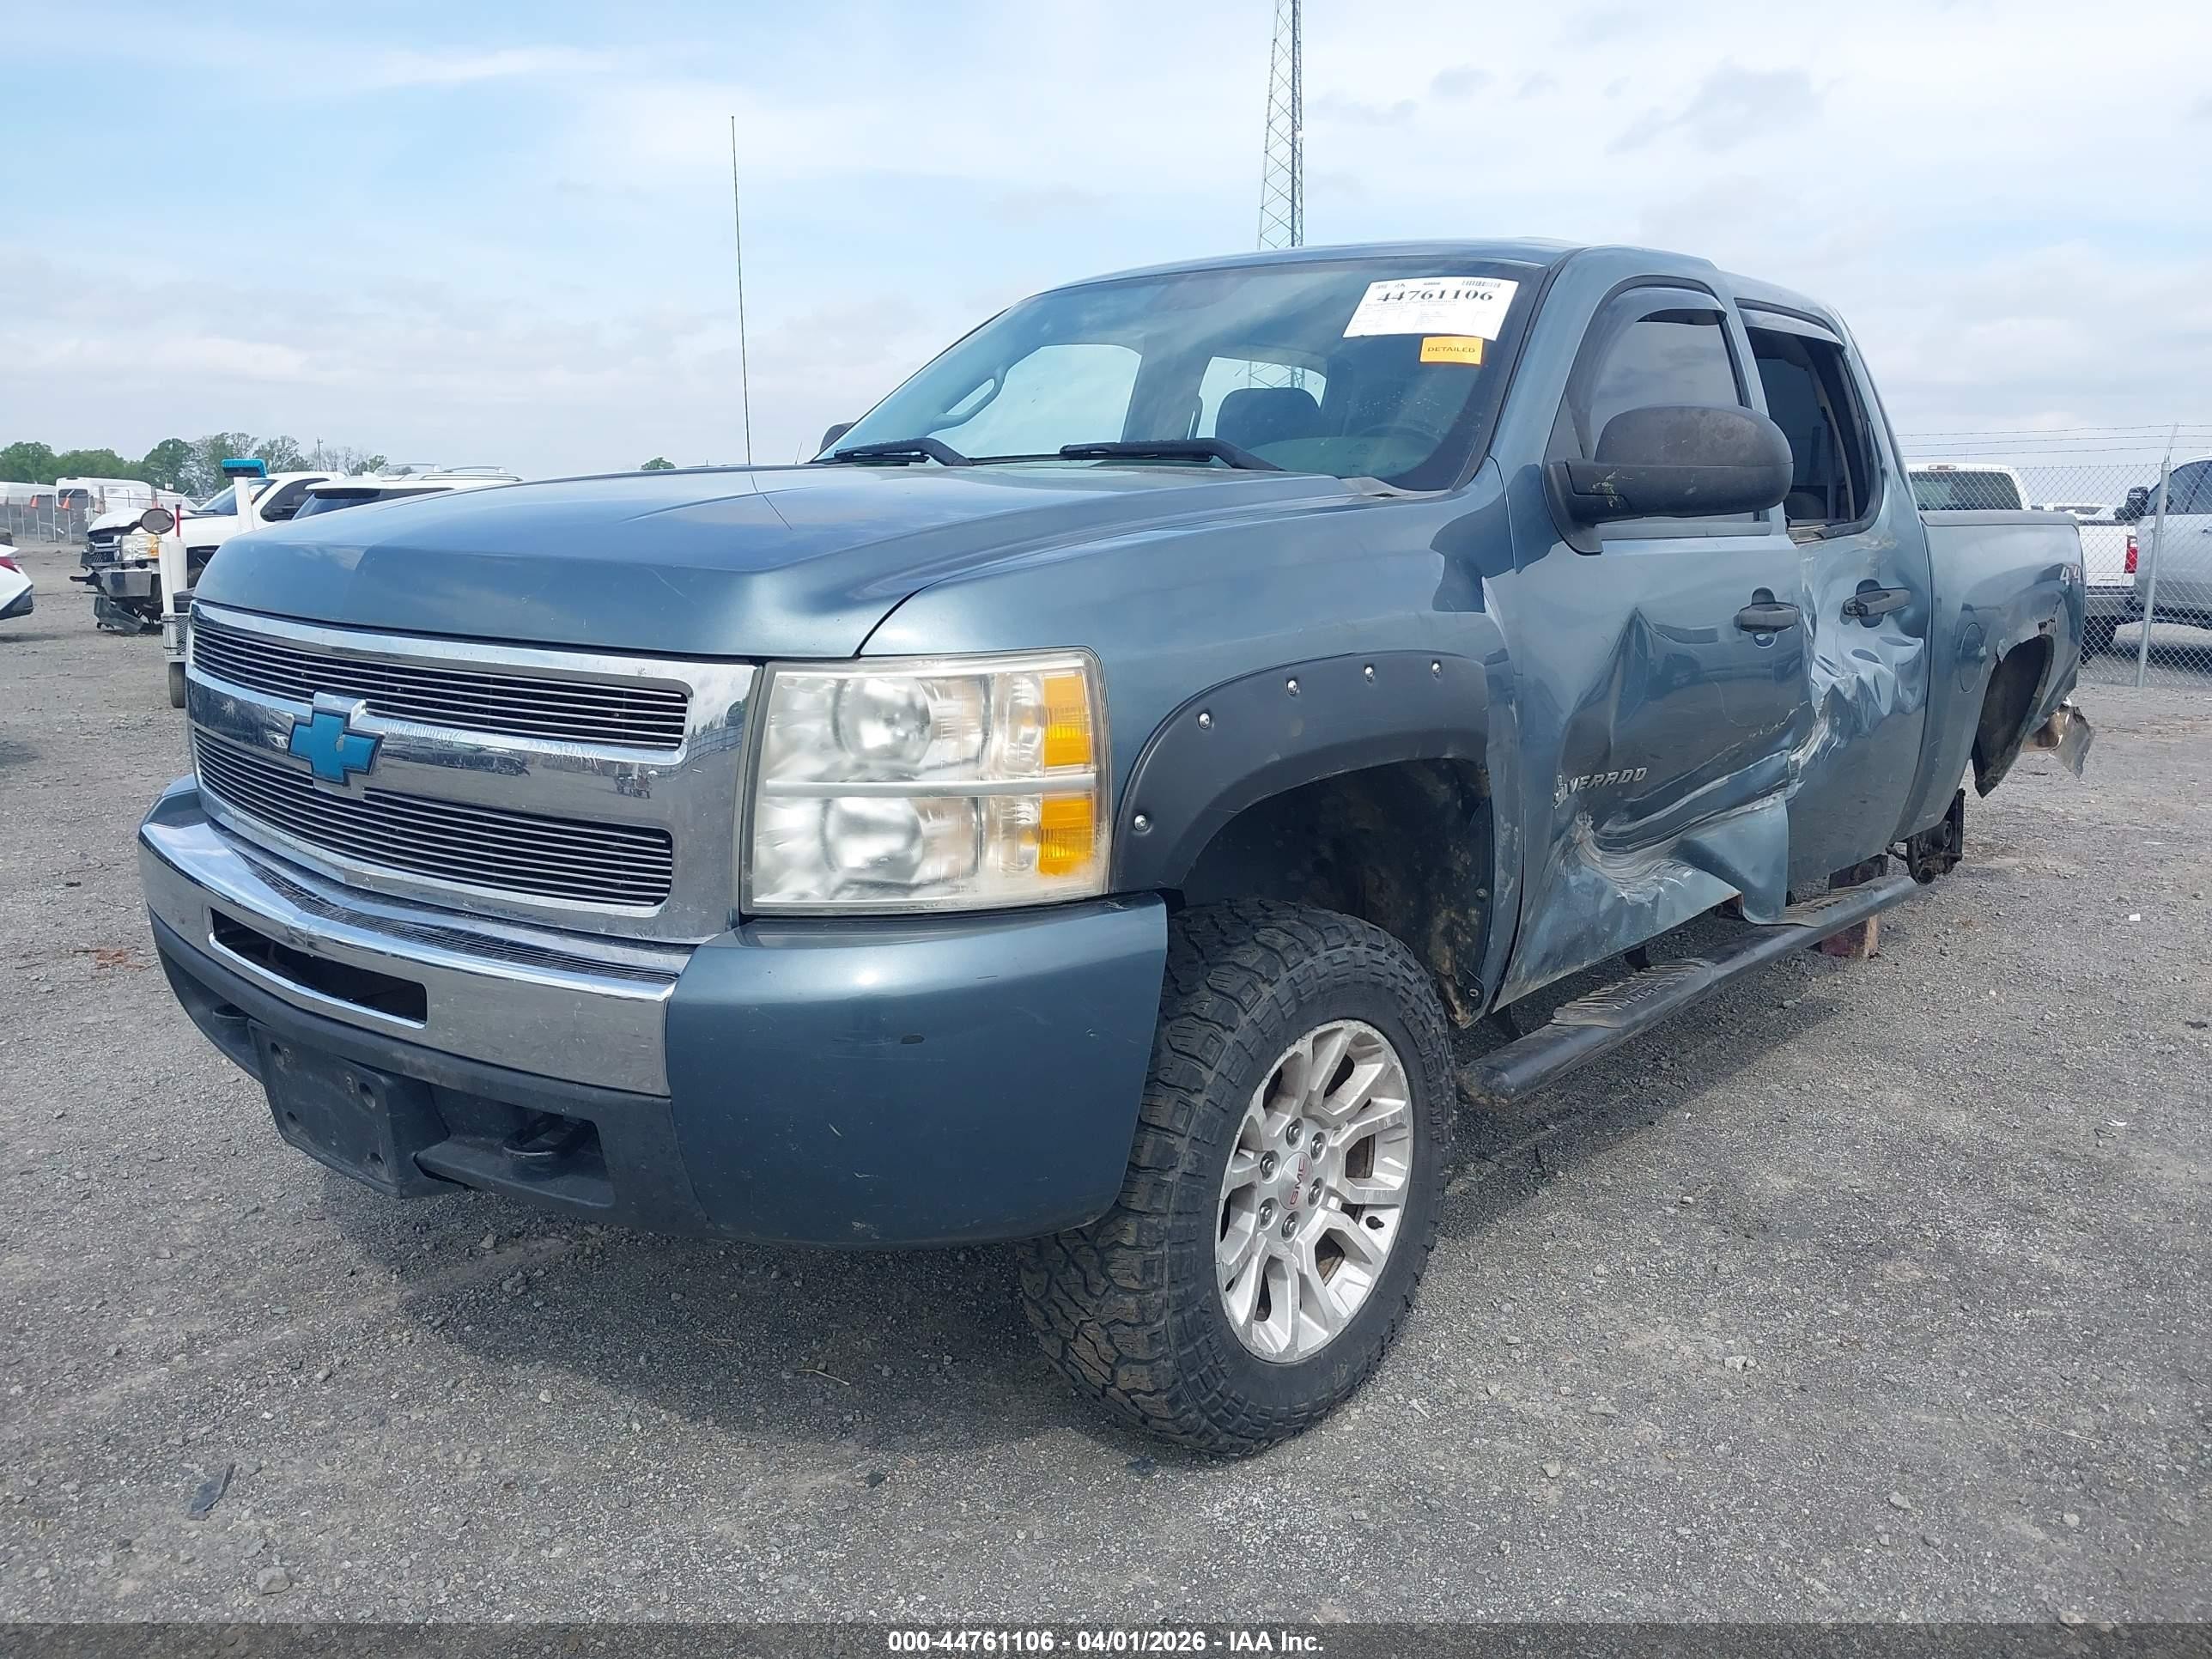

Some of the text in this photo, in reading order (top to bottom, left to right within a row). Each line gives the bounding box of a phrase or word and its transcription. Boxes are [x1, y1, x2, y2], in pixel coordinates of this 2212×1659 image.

[1376, 289, 1494, 302] 44761106
[1427, 345, 1476, 354] DETAILED
[2059, 565, 2082, 586] 44
[1290, 1157, 1305, 1205] GMC
